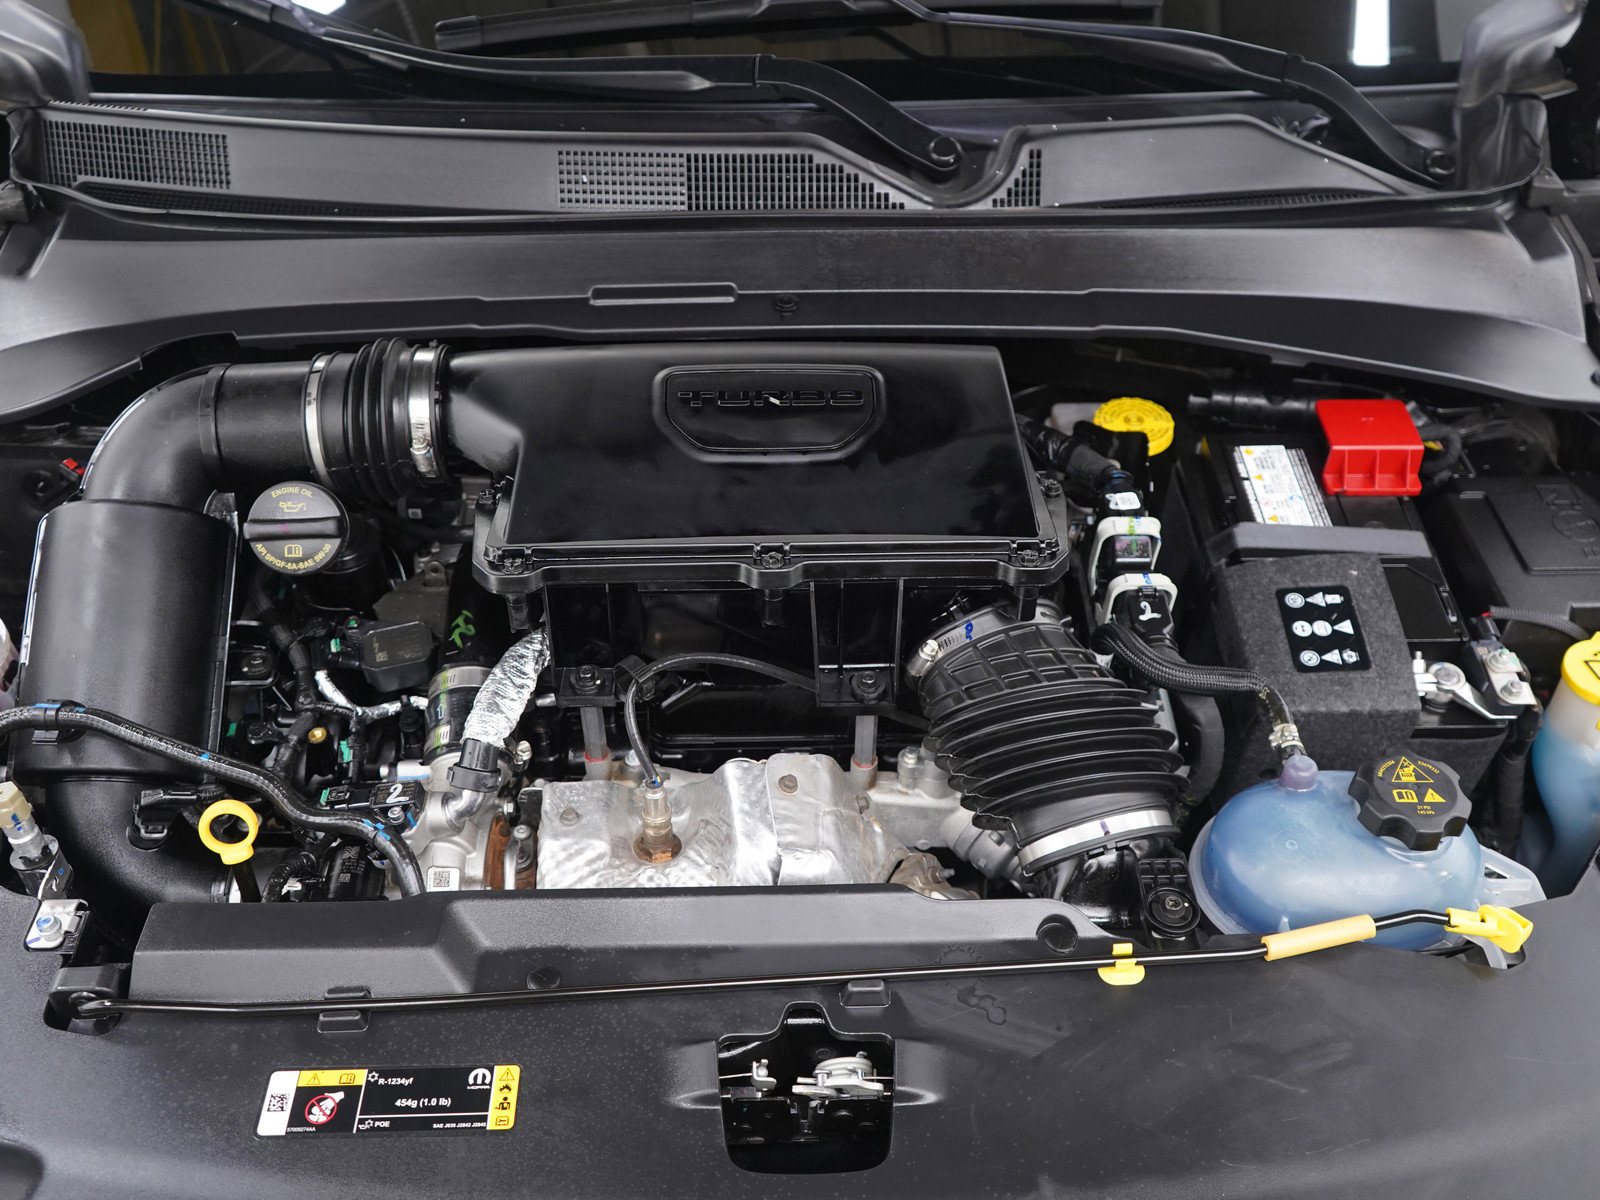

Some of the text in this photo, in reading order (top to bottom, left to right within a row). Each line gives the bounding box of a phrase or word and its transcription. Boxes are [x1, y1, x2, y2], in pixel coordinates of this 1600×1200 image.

[678, 390, 864, 407] TURBO
[271, 486, 313, 498] ENGINE OIL
[256, 543, 267, 556] API
[314, 543, 332, 562] 5W-30
[386, 783, 410, 804] 2
[378, 1077, 414, 1086] R-1234yf
[394, 1097, 452, 1108] 454g (1.0 lb)
[374, 1120, 390, 1128] POE
